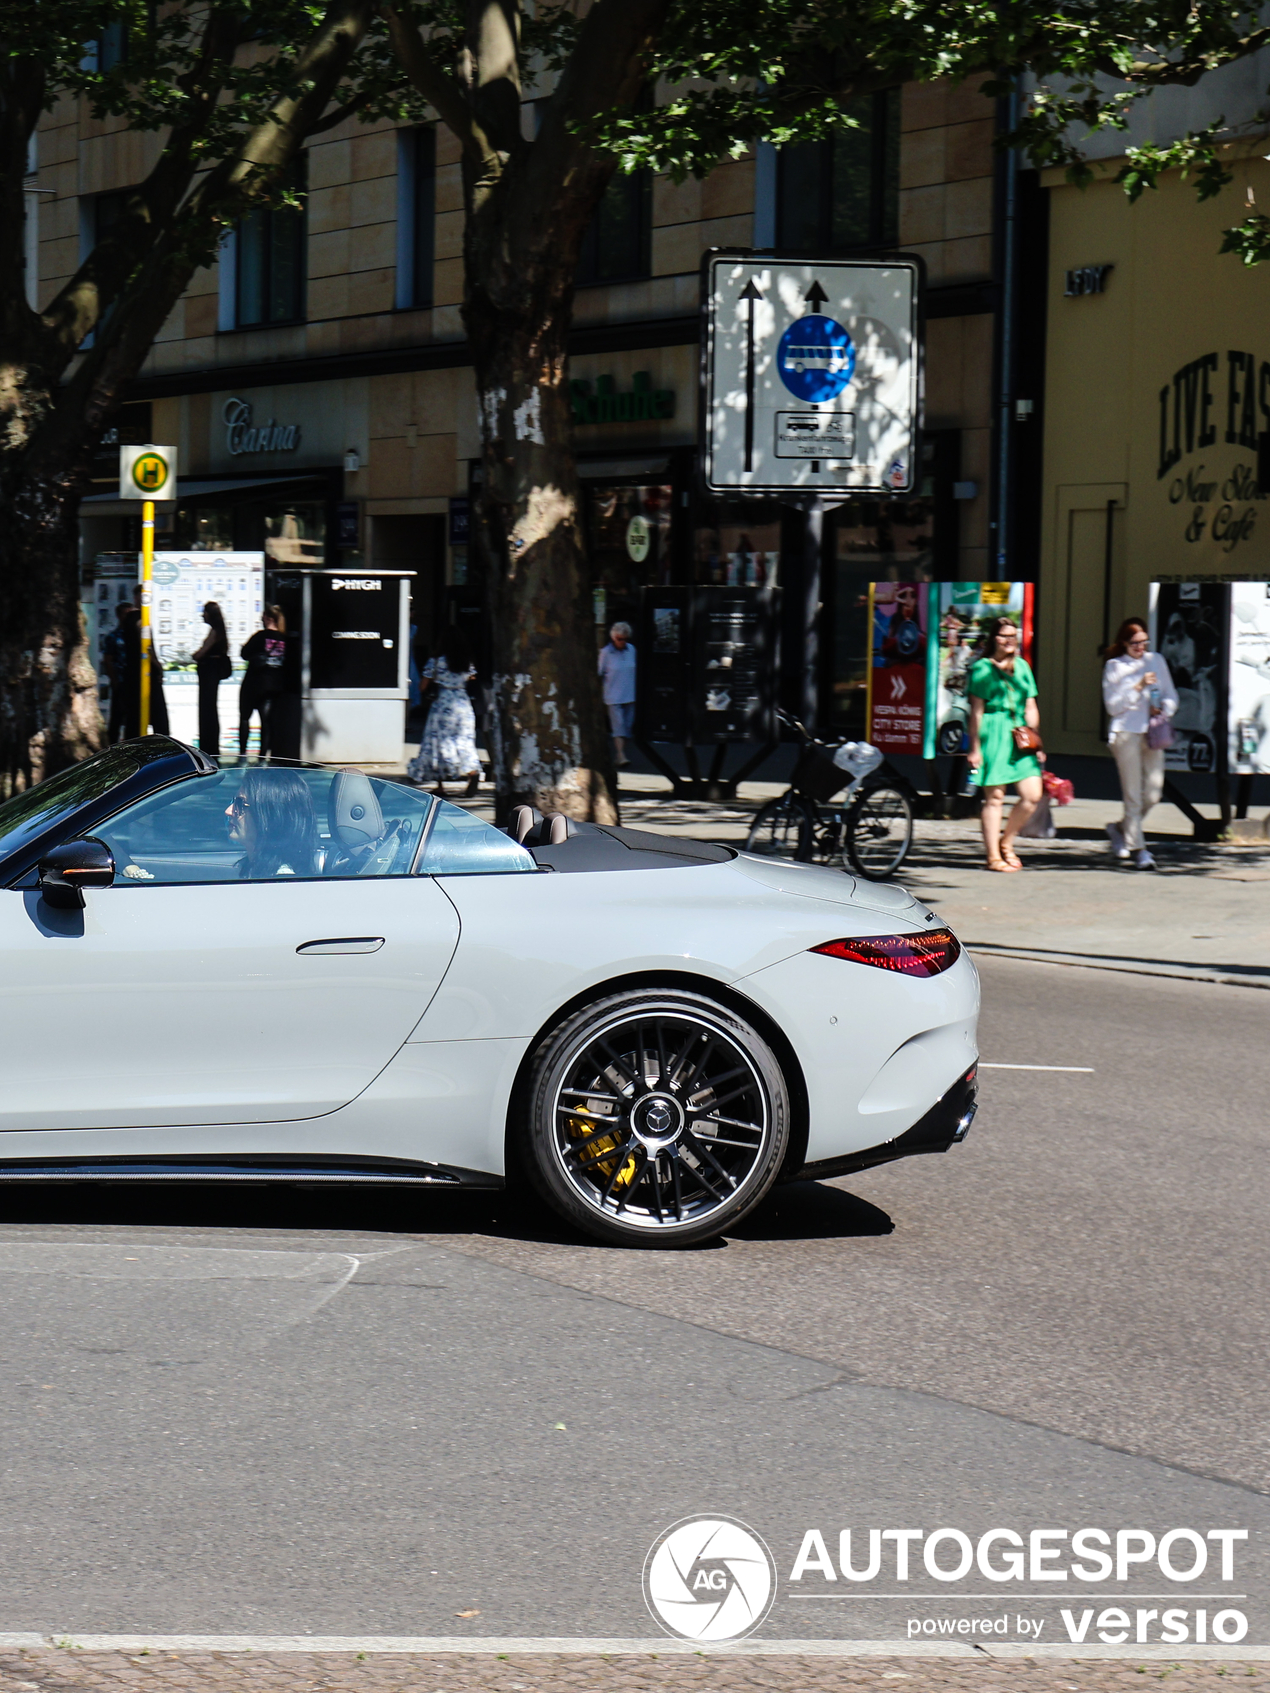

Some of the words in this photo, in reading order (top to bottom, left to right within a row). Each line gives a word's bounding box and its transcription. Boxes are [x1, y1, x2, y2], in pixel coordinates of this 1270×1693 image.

[570, 371, 675, 425] Schuhe
[1157, 351, 1217, 480] LIVE
[223, 398, 298, 455] Carina
[142, 462, 159, 484] H
[1169, 465, 1218, 503] New
[1185, 505, 1206, 542] &
[1211, 504, 1257, 553] Café
[872, 718, 891, 729] CITY
[893, 719, 922, 732] STORE
